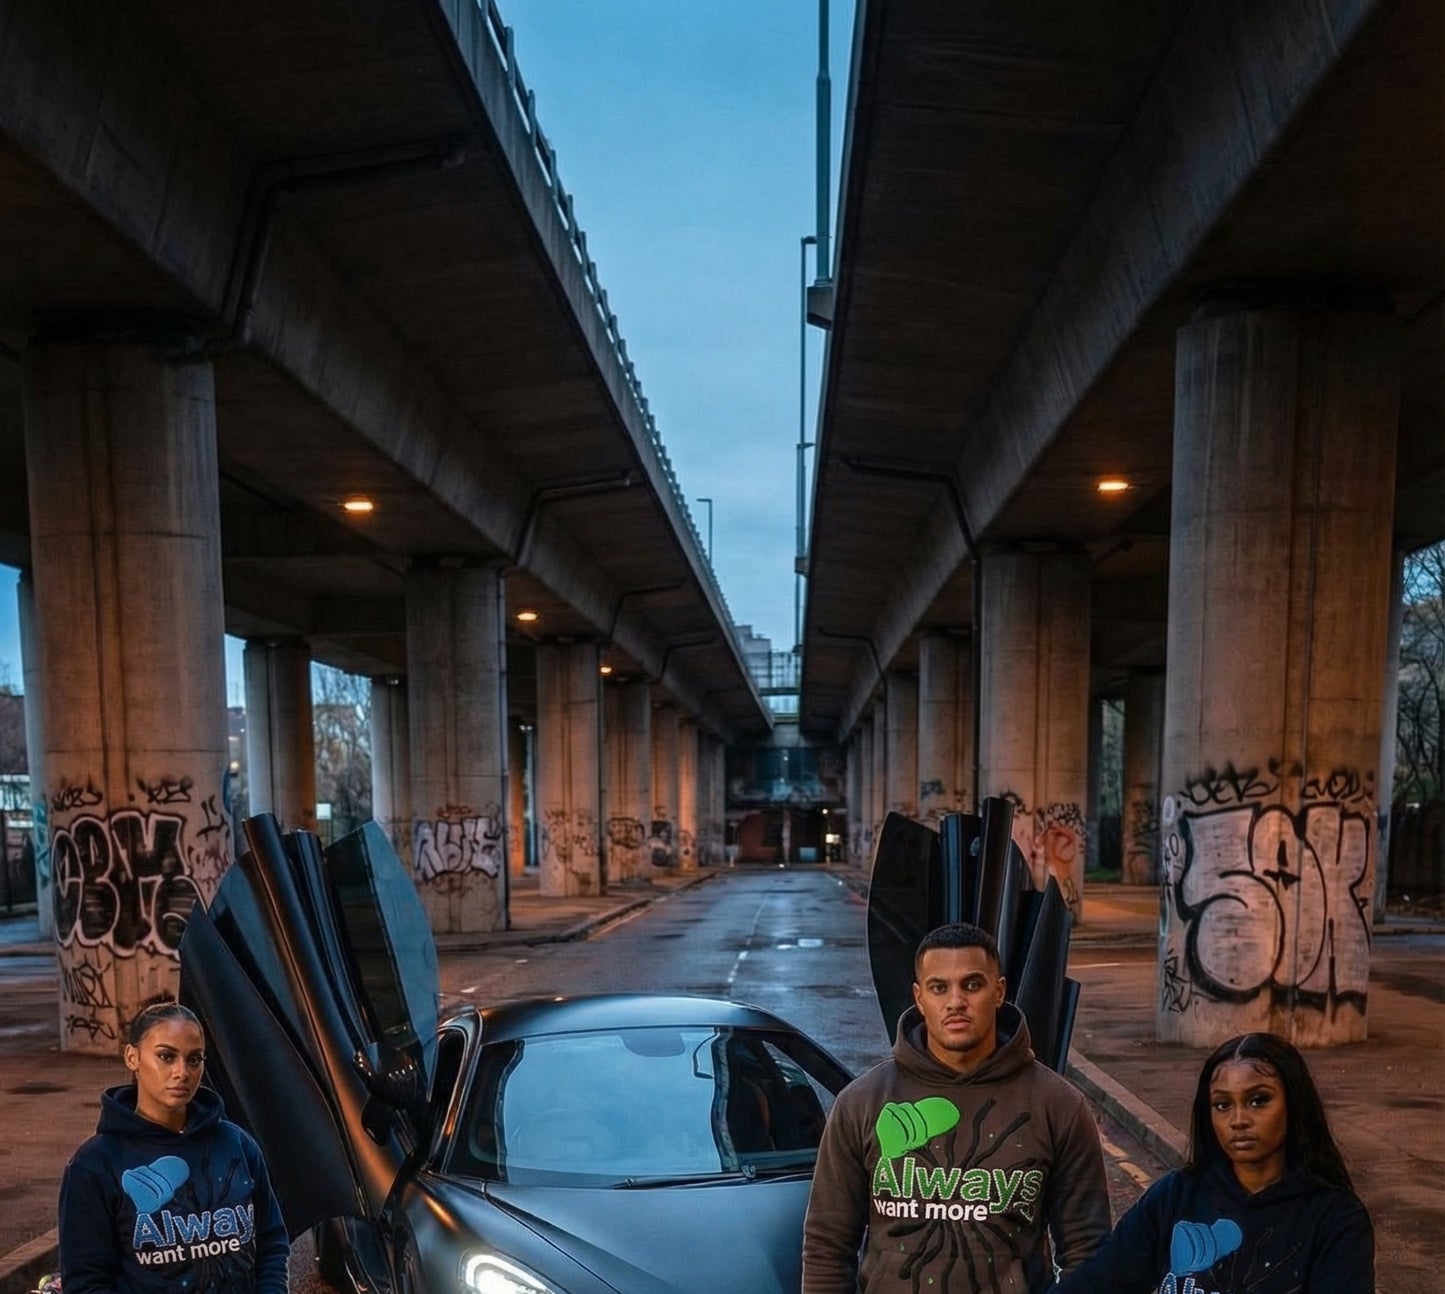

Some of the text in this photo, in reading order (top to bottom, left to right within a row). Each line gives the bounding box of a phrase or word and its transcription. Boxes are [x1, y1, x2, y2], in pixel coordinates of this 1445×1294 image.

[873, 1156, 1043, 1214] Always
[874, 1199, 987, 1221] want more
[136, 1238, 240, 1265] want more
